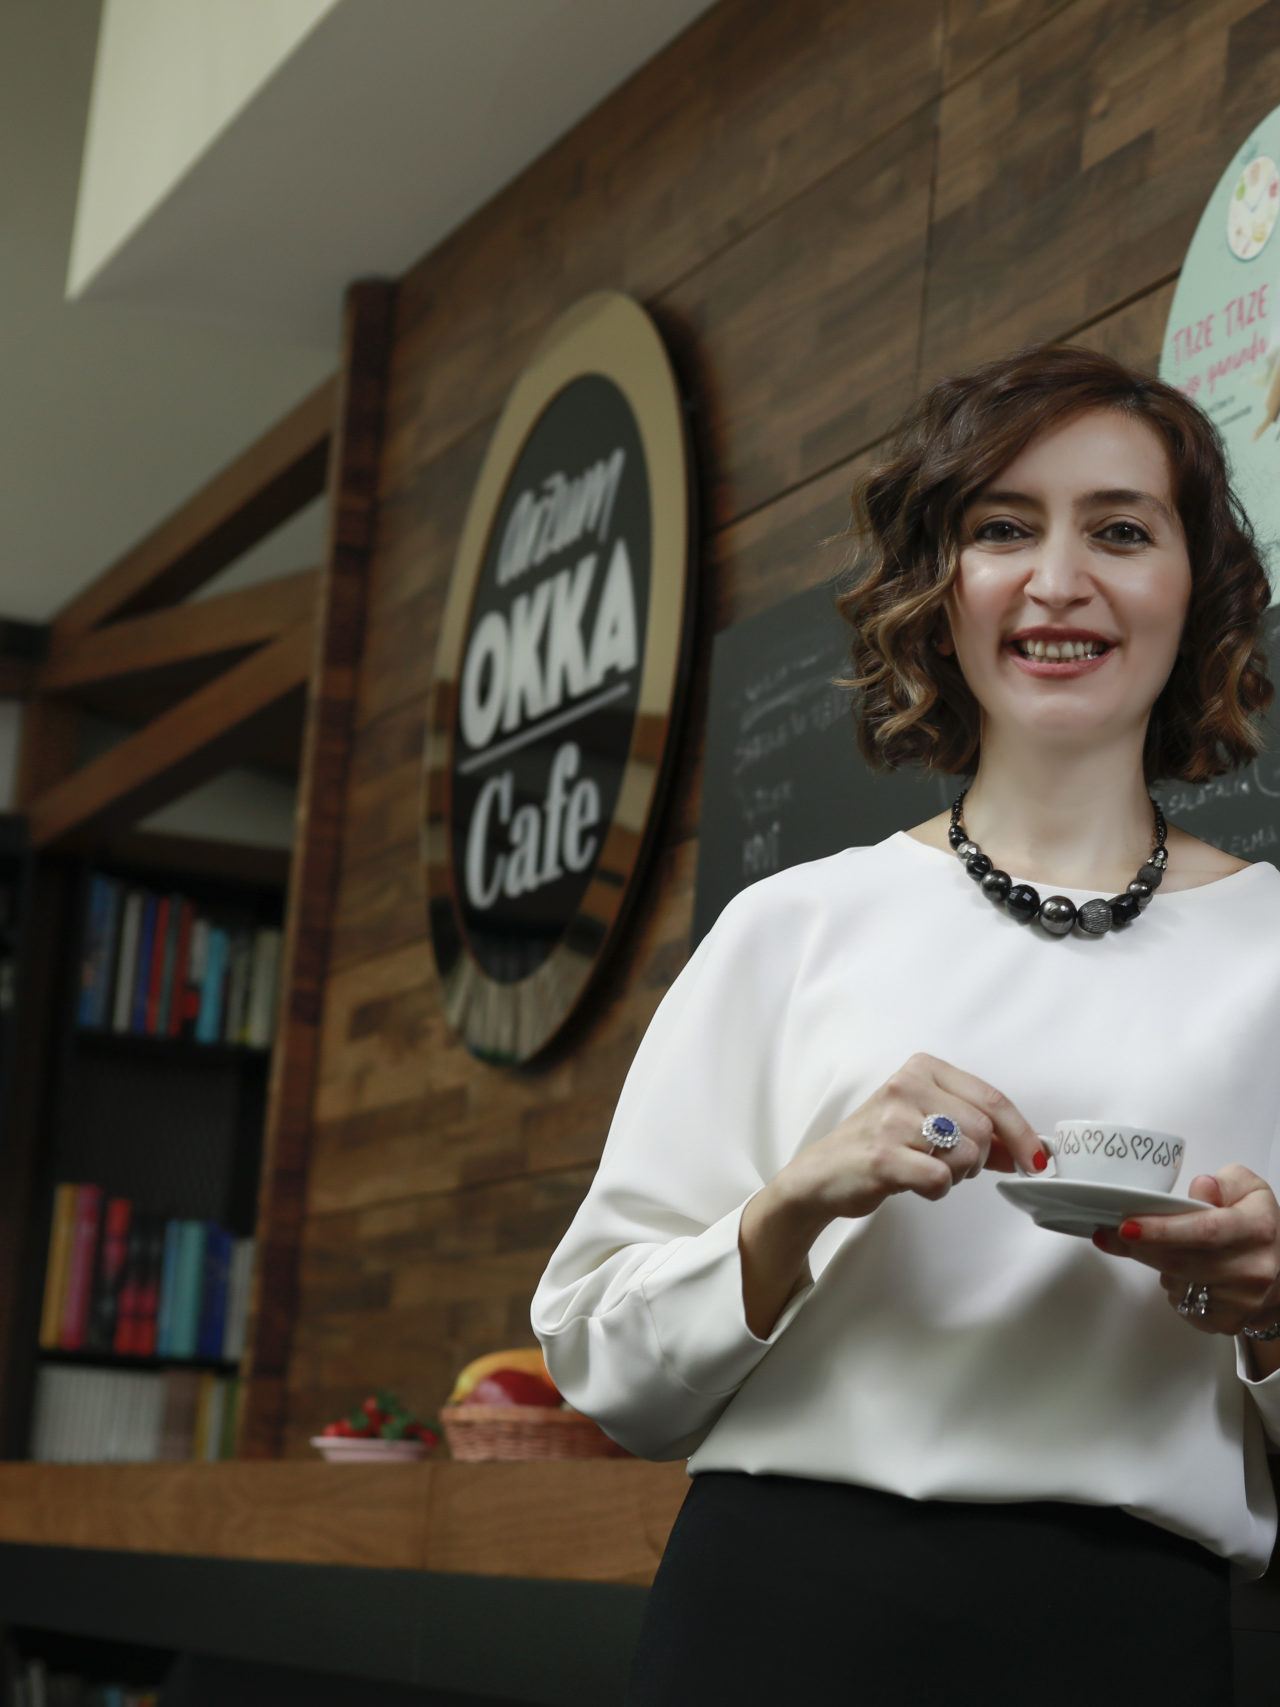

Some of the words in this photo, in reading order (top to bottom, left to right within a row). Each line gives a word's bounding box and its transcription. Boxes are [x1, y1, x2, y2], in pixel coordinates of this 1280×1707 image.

[1172, 313, 1215, 366] TAZE
[1224, 284, 1268, 337] TAZE
[458, 536, 637, 750] OKKA
[464, 741, 601, 911] Cafe
